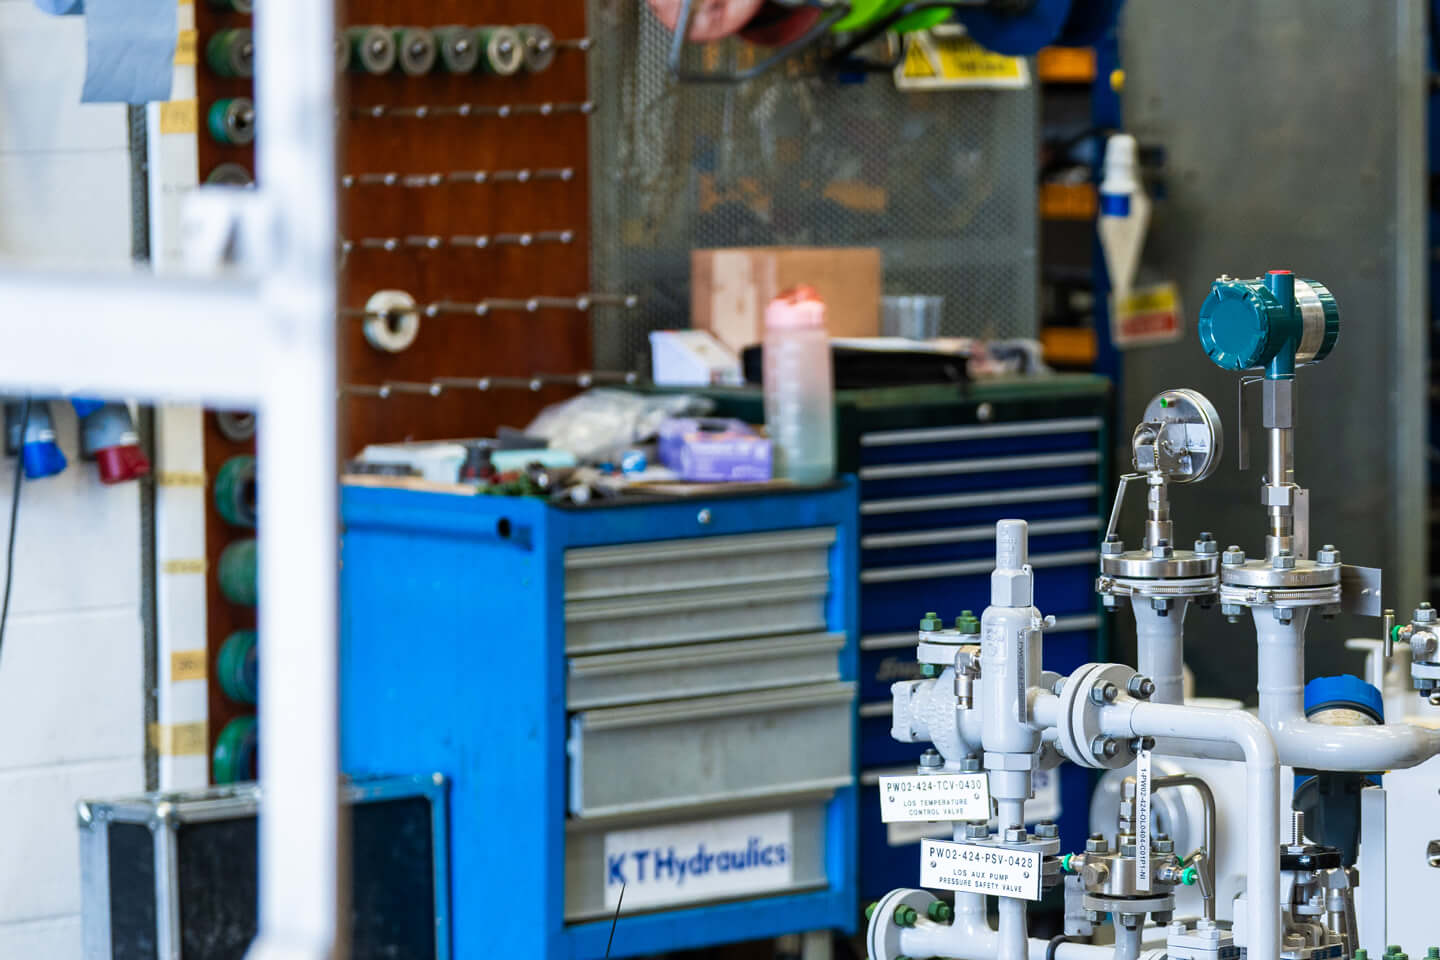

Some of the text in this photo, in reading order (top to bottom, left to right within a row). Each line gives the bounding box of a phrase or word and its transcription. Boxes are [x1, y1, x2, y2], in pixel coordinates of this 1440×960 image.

[886, 779, 982, 792] PW02-424-TCV-0430
[903, 798, 968, 807] LOS TEMPERATURE
[909, 808, 940, 816] CONTROL
[929, 847, 1033, 868] PW02-424-PSV-0428
[953, 869, 1009, 881] LOS AUX PUMP
[939, 877, 1022, 893] PRESSURE SAFETY VALVE
